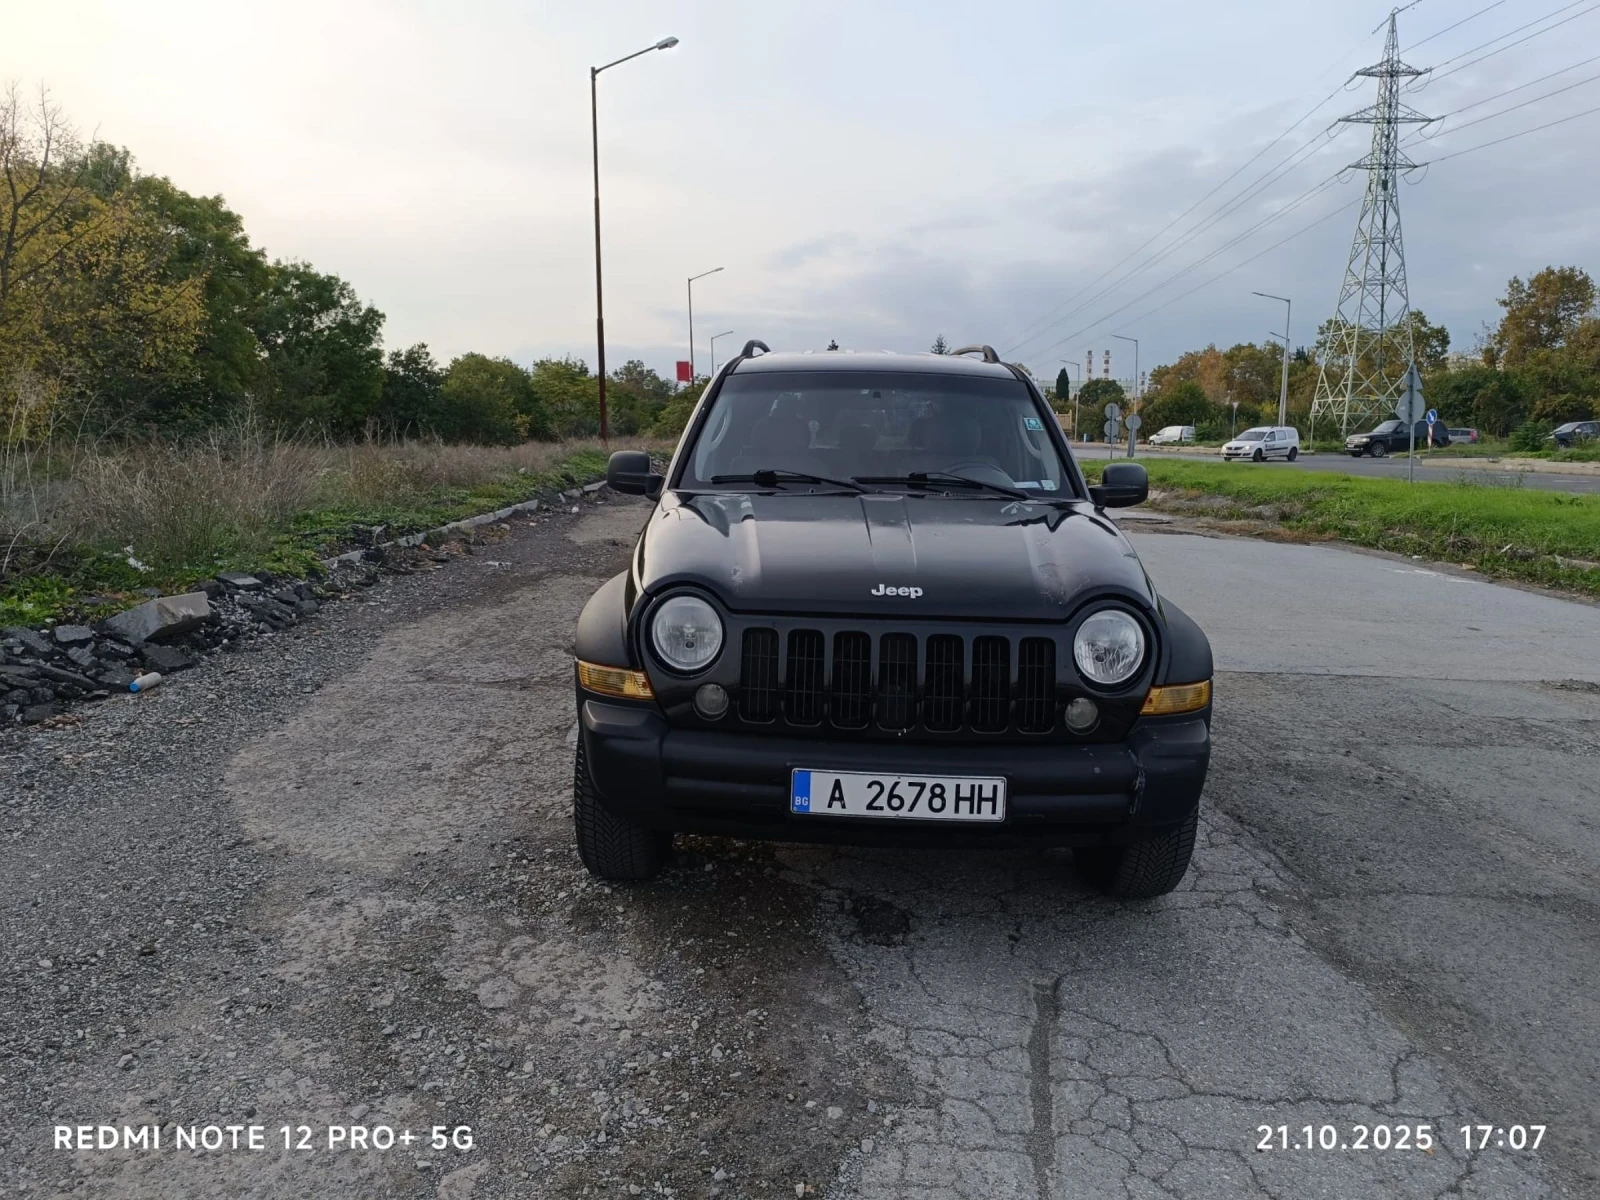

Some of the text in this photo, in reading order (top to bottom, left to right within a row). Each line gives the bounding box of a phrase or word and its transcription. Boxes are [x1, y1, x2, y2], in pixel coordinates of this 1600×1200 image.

[871, 583, 924, 599] Jeep
[794, 796, 809, 806] BG
[827, 778, 847, 810] A
